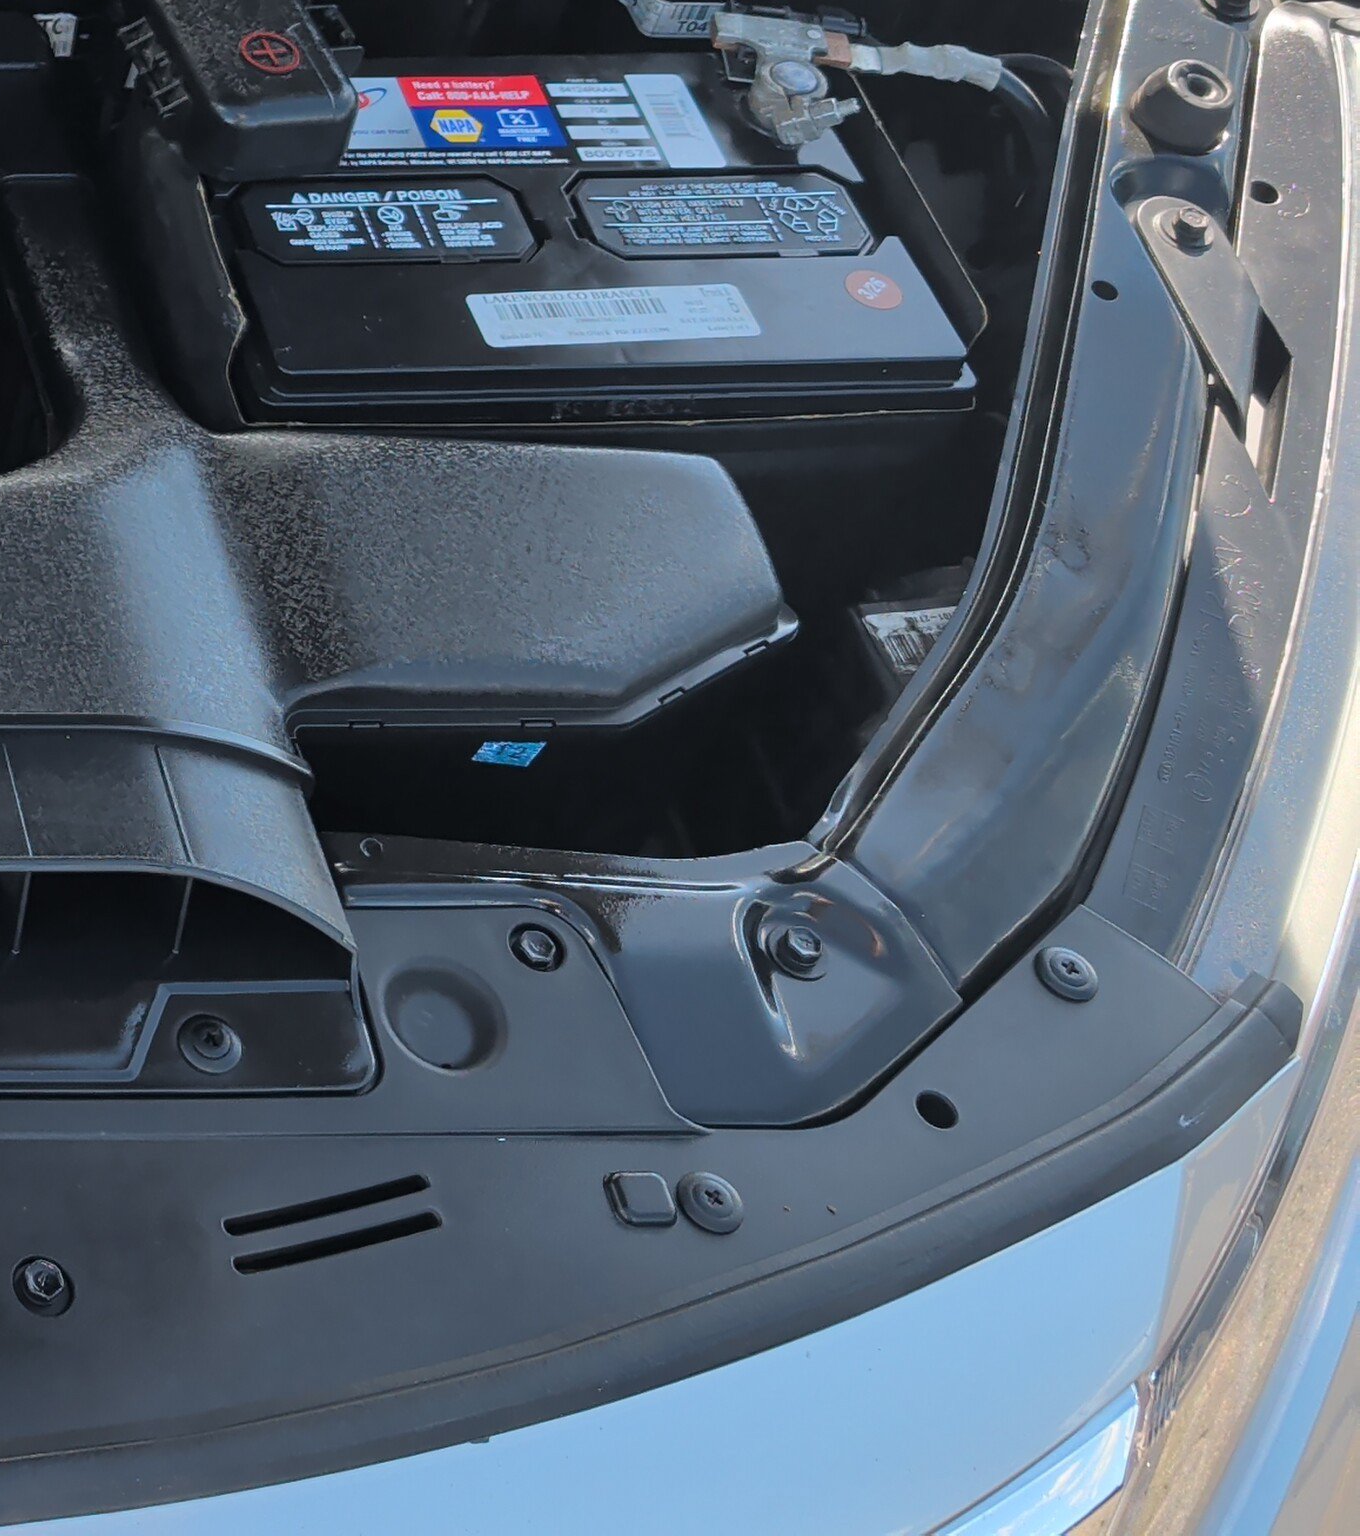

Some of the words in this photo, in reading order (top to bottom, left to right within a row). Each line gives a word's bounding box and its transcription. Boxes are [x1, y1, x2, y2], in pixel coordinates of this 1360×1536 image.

[412, 80, 440, 90] Need
[443, 82, 449, 90] a
[451, 79, 496, 91] battery?
[416, 91, 444, 101] Call:
[446, 90, 530, 101] 800-AAA-HELP
[436, 118, 477, 134] NAPA
[352, 128, 371, 137] you
[307, 191, 381, 204] DANGER
[396, 188, 462, 202] POISON
[632, 200, 662, 208] FLUSH
[662, 199, 688, 207] EYES
[482, 292, 564, 305] LAKEWOOD
[567, 291, 588, 301] CO
[591, 288, 651, 300] BRANCH
